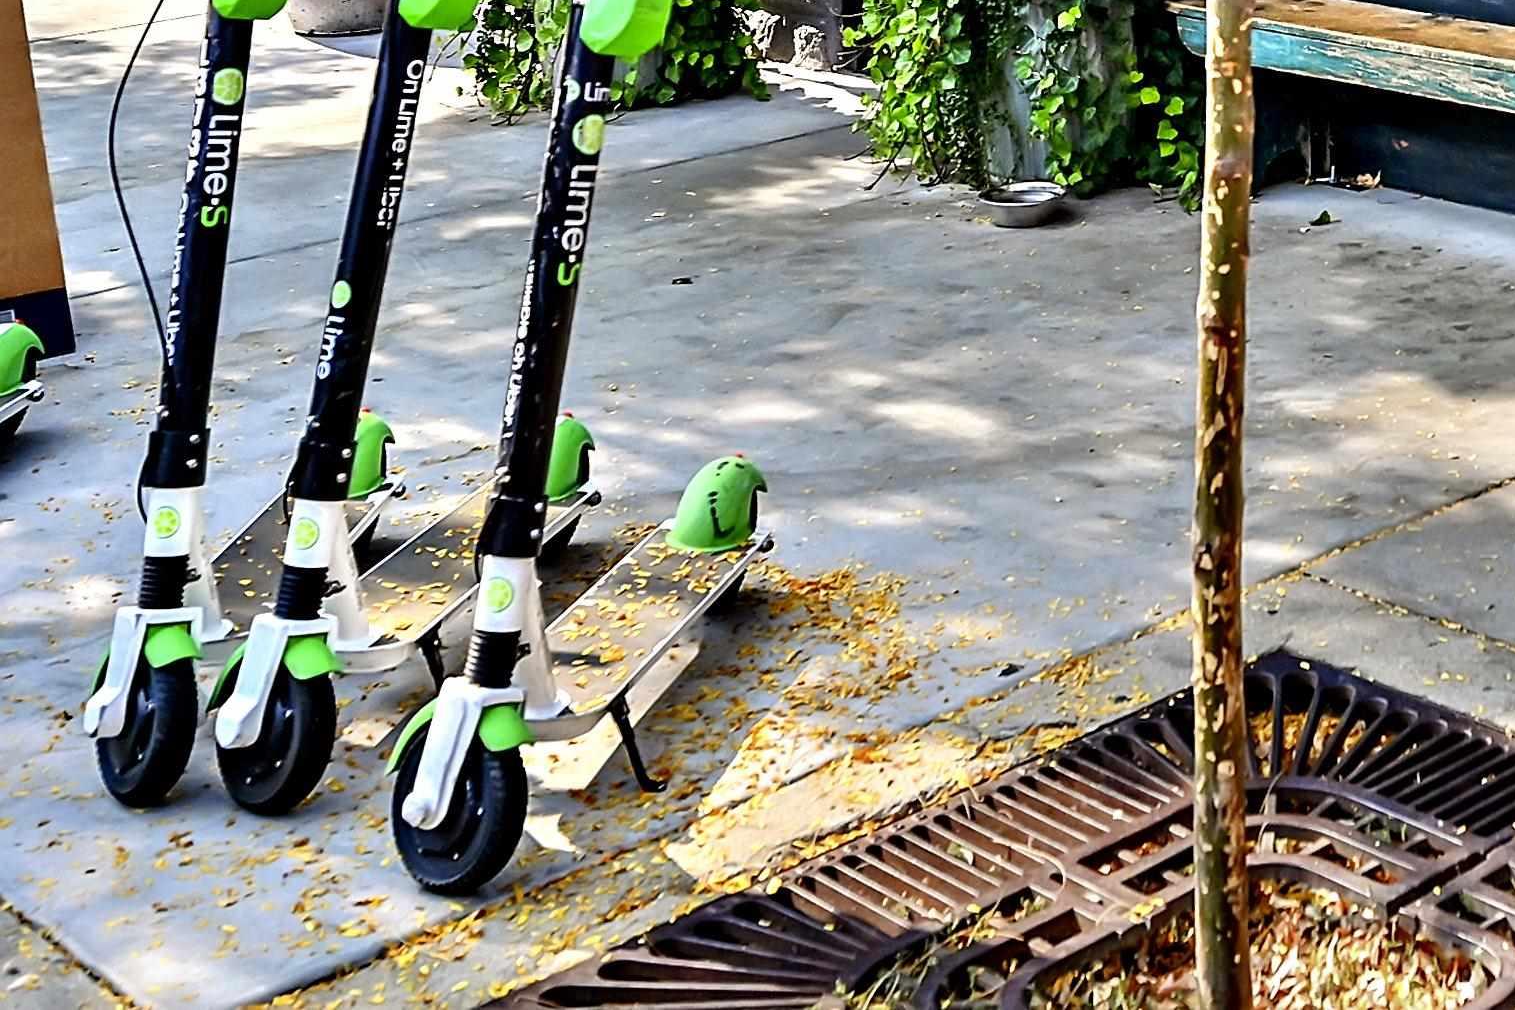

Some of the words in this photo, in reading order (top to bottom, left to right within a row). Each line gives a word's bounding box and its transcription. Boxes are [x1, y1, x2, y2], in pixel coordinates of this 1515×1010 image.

[402, 59, 424, 93] On
[391, 98, 418, 153] Lime
[317, 315, 346, 380] Lime
